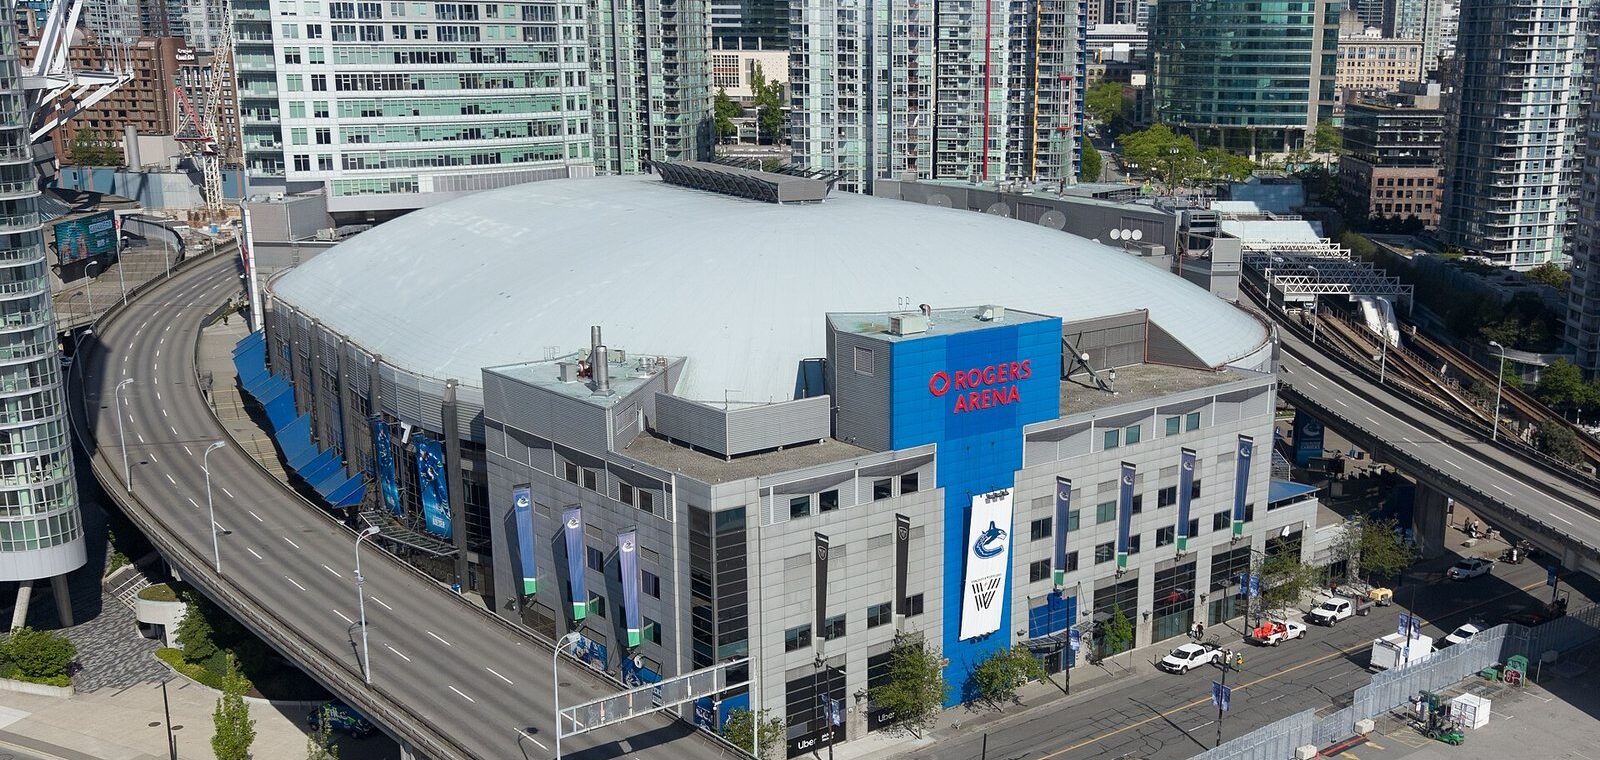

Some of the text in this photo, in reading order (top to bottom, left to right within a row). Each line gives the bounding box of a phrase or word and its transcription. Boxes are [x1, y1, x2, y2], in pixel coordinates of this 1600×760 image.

[954, 359, 1032, 391] ROGERS
[953, 384, 1021, 414] ARENA
[400, 421, 412, 443] 7
[797, 738, 817, 750] Uber
